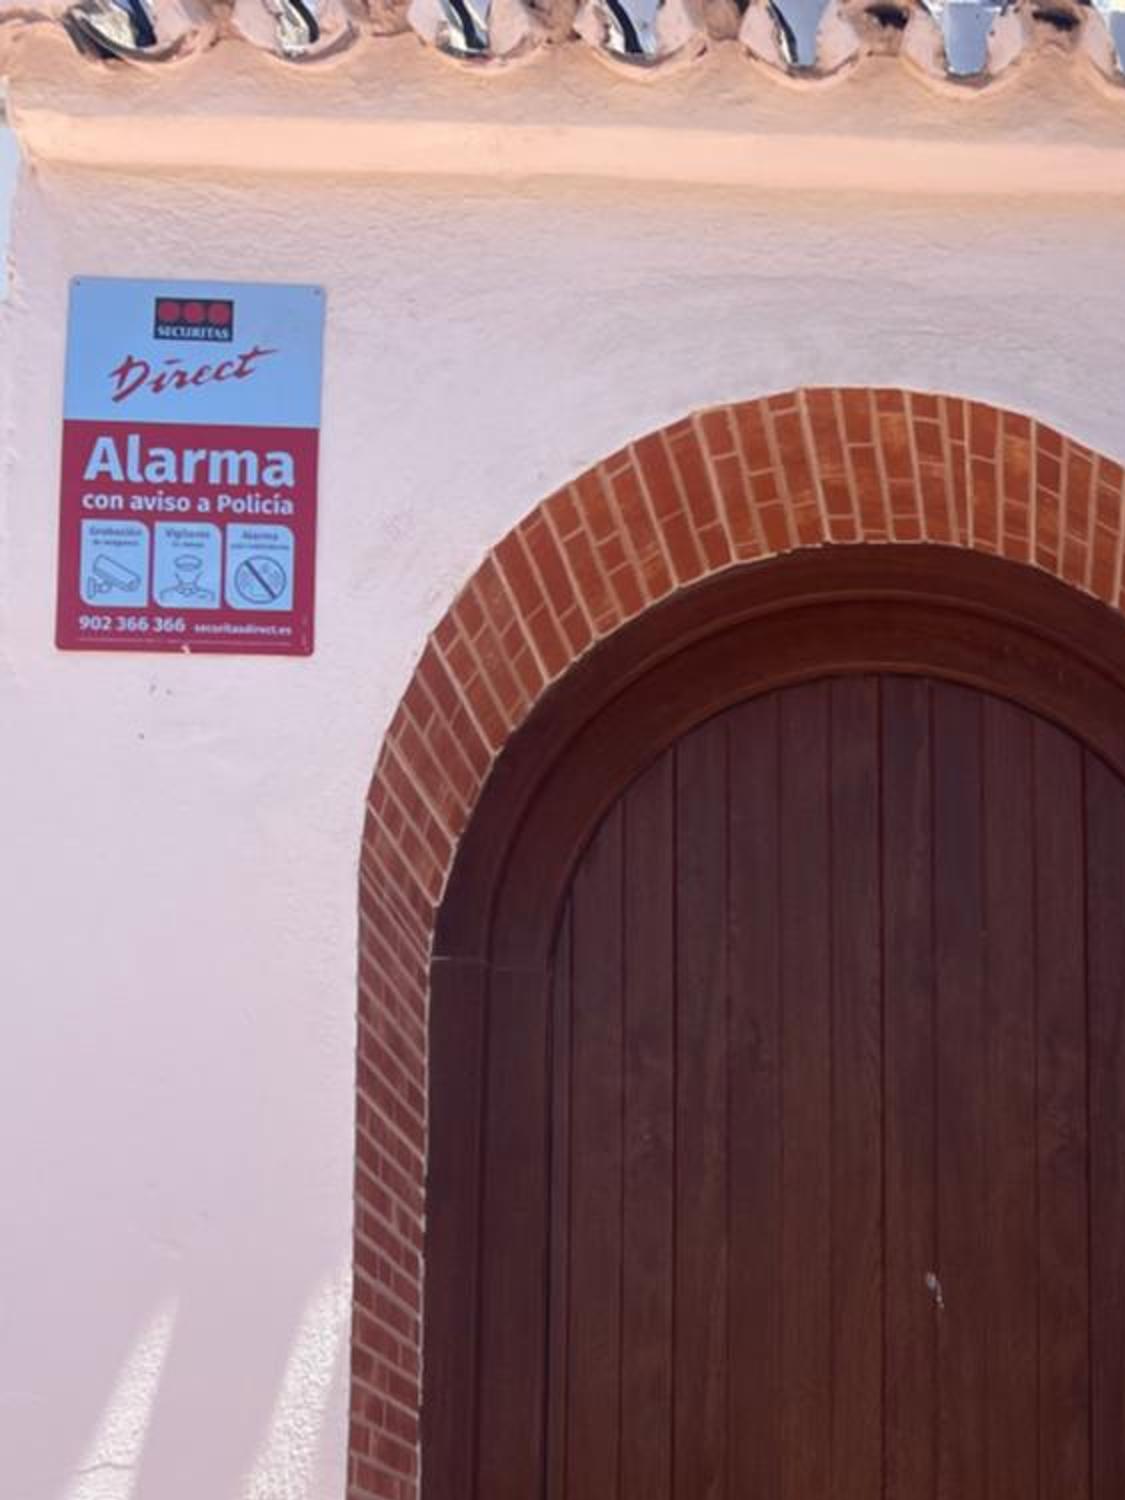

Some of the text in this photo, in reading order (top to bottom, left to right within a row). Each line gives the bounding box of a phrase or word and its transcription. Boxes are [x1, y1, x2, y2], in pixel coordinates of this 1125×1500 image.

[157, 326, 229, 339] SECURITAS
[108, 346, 278, 402] Direct
[83, 434, 295, 487] Alarma
[82, 490, 294, 515] con aviso a Policía
[79, 614, 112, 631] 902
[114, 615, 149, 632] 366
[152, 616, 186, 633] 366
